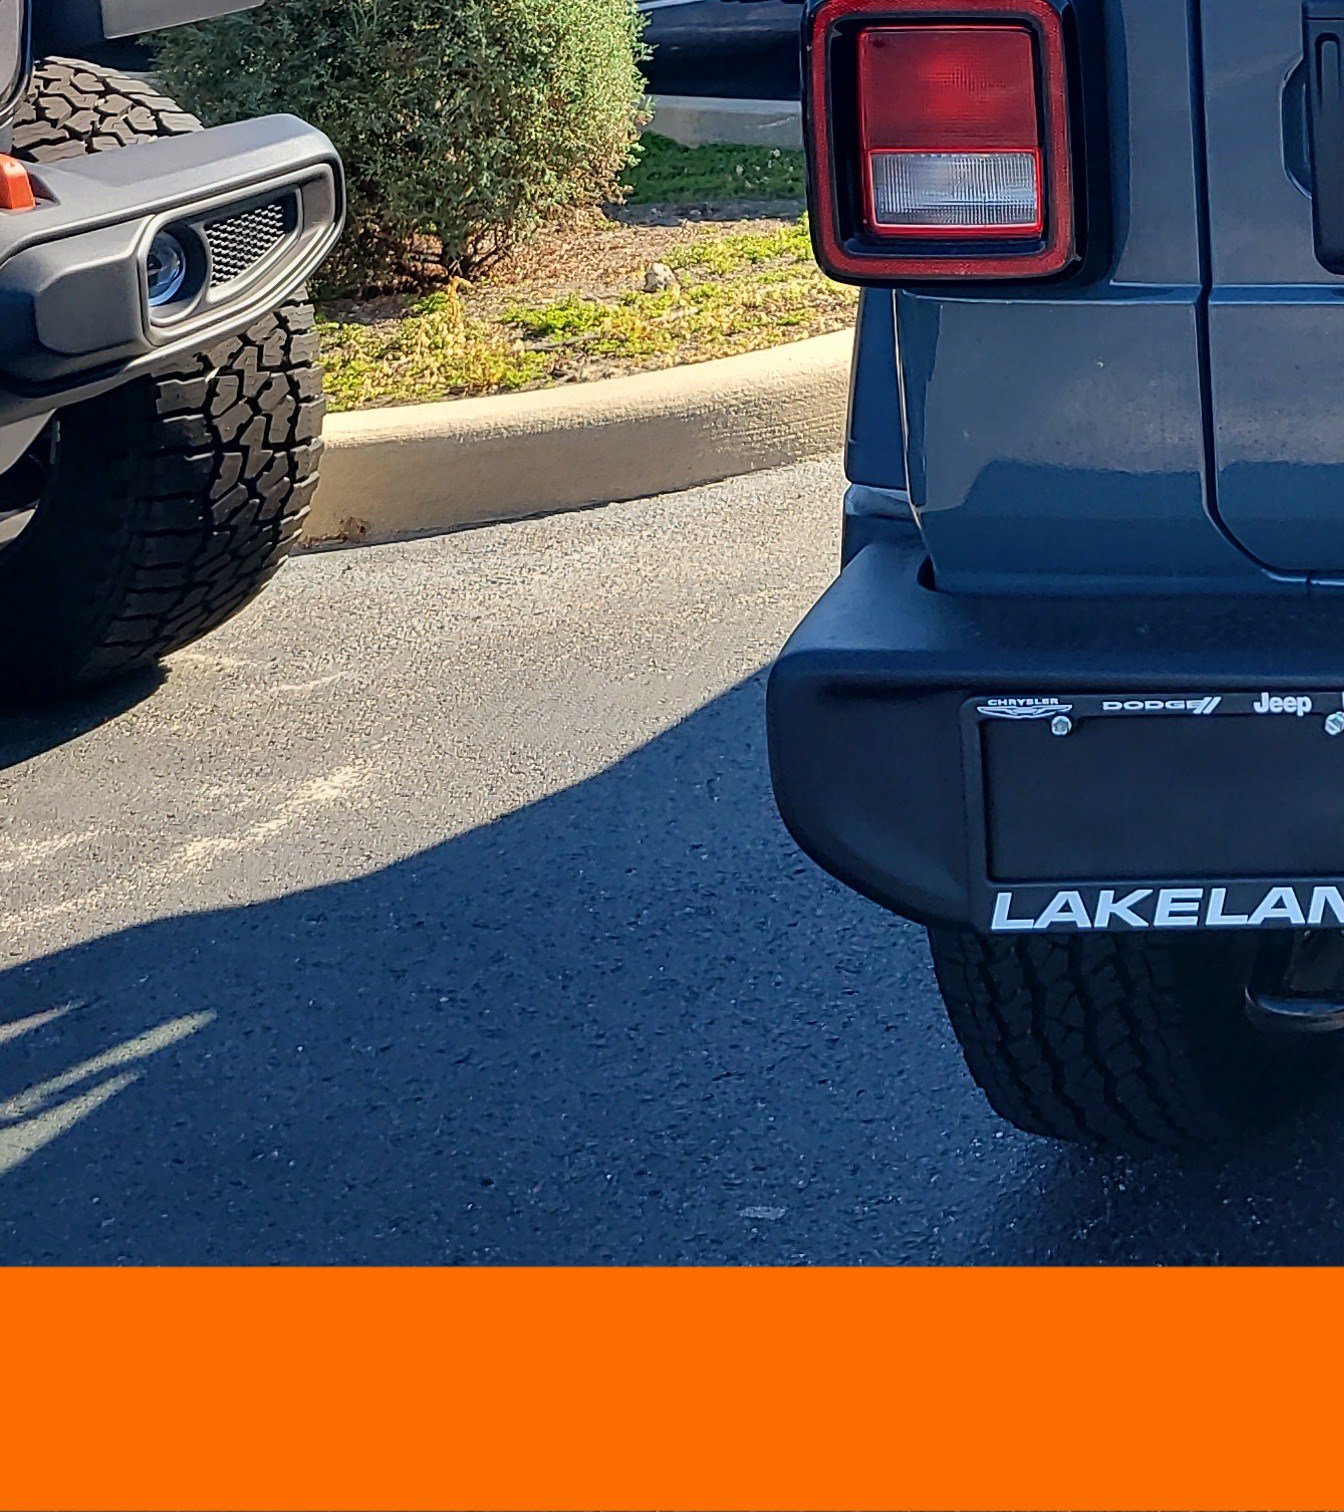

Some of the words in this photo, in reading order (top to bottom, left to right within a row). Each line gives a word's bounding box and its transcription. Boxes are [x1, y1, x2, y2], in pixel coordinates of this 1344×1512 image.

[987, 697, 1060, 707] CHRYSLER
[1102, 699, 1202, 713] DODGE
[1253, 692, 1313, 717] Jeep
